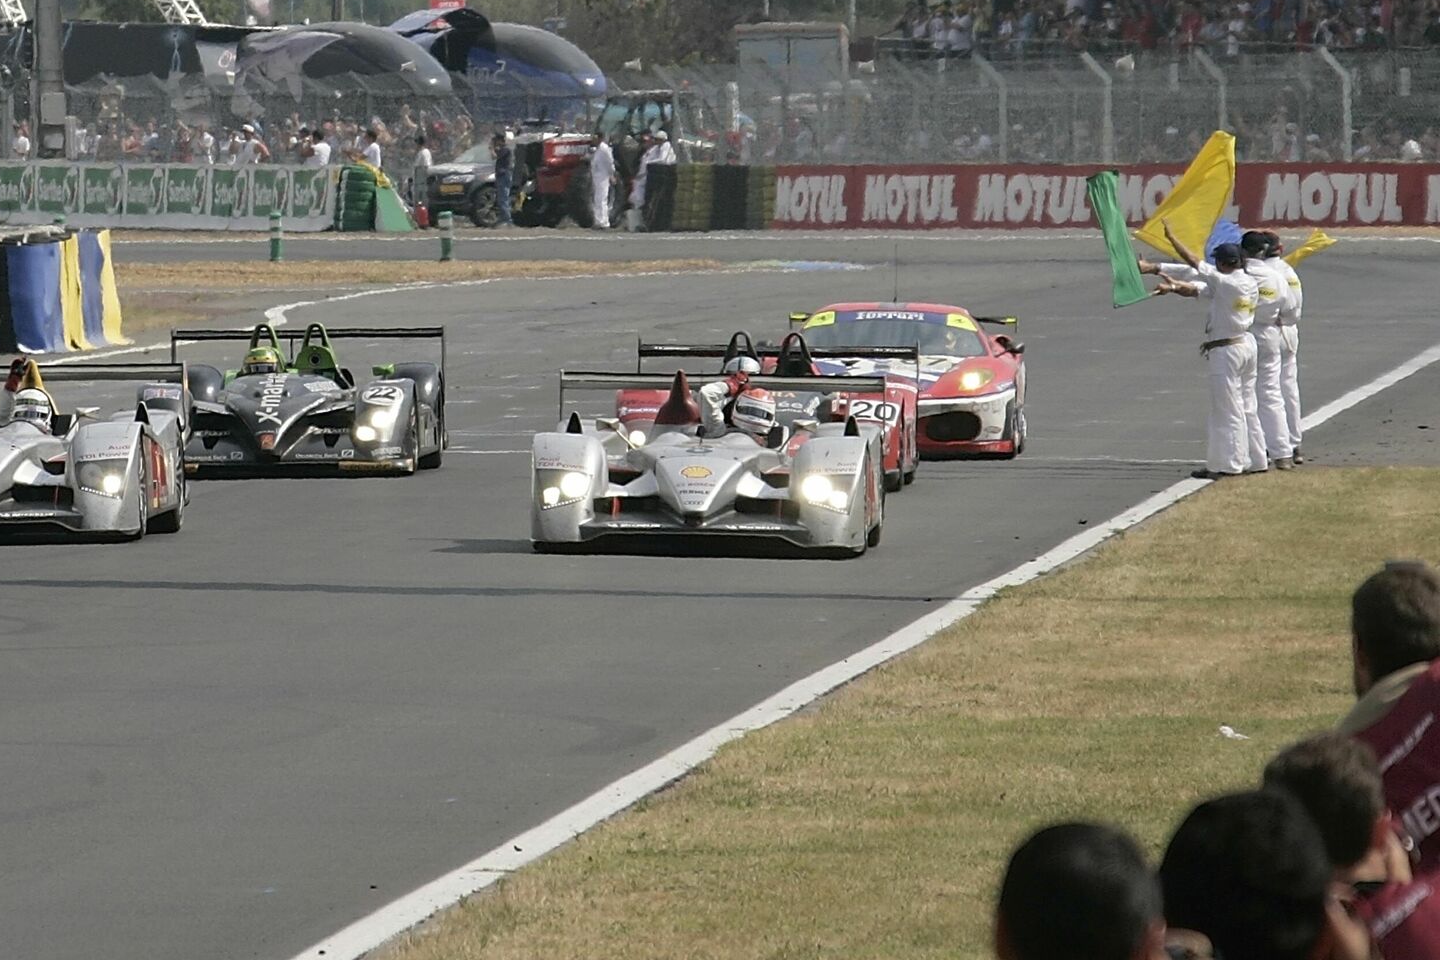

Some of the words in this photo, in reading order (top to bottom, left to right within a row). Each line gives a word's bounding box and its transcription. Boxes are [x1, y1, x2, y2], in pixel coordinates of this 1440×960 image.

[774, 174, 847, 224] MOTUL
[863, 174, 958, 224] MOTUL
[974, 173, 1091, 223] MOTUL
[1262, 172, 1402, 223] MOTUL
[855, 311, 925, 321] Ferrari
[368, 386, 396, 400] 22
[851, 401, 897, 421] 20
